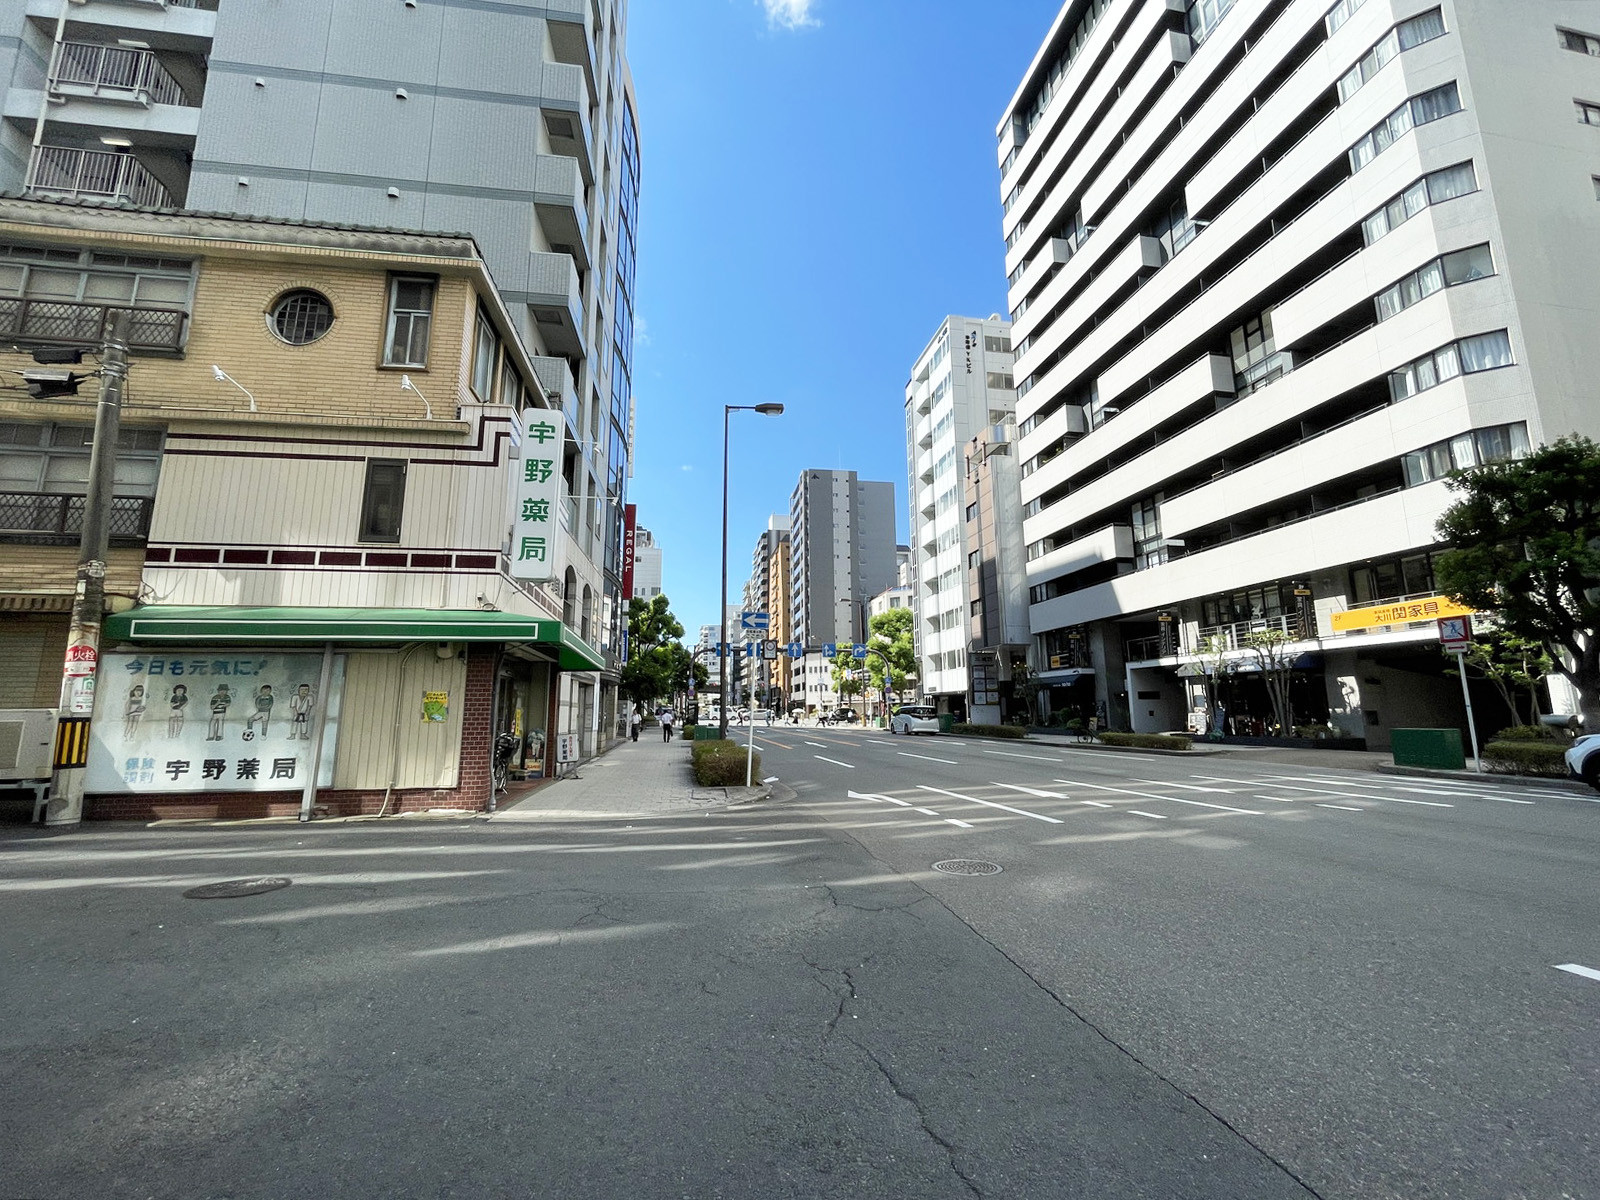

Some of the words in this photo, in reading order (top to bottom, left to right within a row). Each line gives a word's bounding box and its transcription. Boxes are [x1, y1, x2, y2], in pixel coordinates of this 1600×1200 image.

[518, 421, 556, 562] 宇野薬局
[625, 530, 634, 573] REGAL
[125, 659, 267, 676] 今日も元気に!
[165, 757, 297, 781] 宇野薬局
